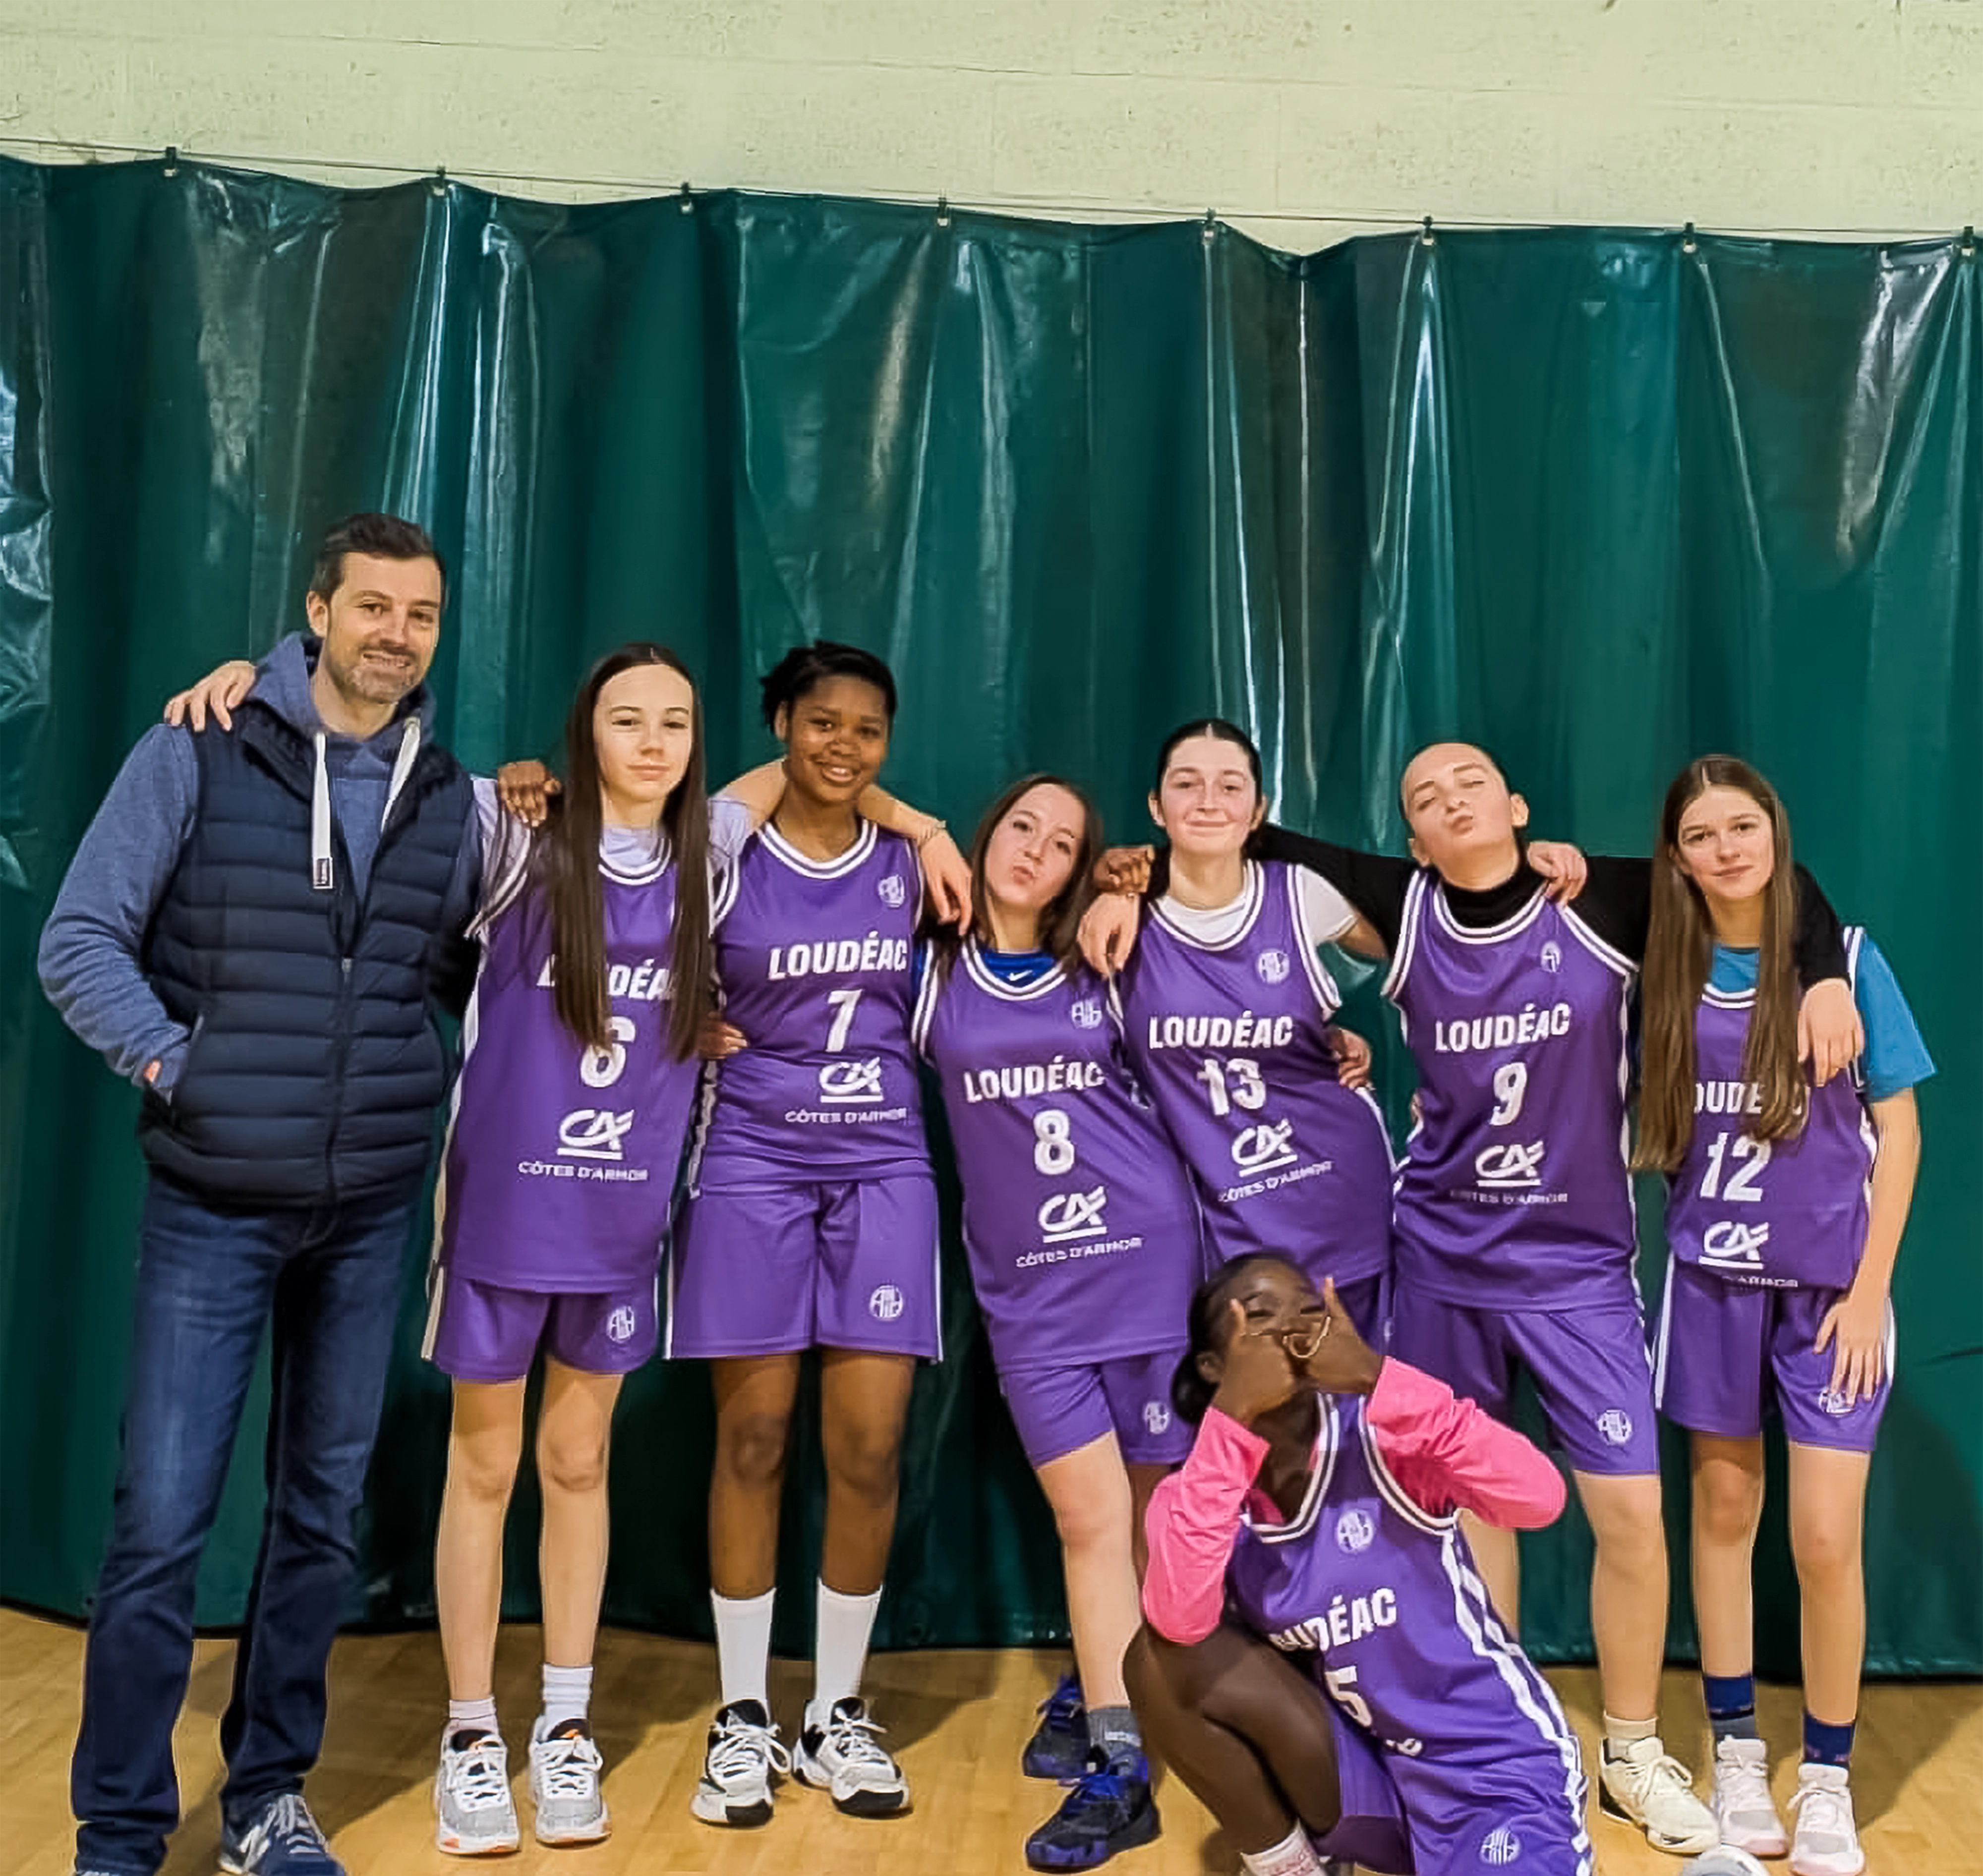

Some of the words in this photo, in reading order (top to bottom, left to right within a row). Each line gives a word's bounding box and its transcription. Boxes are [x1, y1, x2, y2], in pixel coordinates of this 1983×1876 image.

[536, 954, 673, 1001] LDÉA
[768, 931, 908, 981] LOUDÉAC
[825, 988, 863, 1053] 7
[1149, 1010, 1293, 1049] LOUDÉAC
[1435, 1002, 1572, 1053] LOUDÉAC
[580, 1016, 636, 1088] 6
[963, 1055, 1105, 1103] LOUDÉAC
[1197, 1058, 1266, 1116] 13
[1489, 1061, 1528, 1126] 9
[1033, 1109, 1075, 1175] 8
[1699, 1132, 1772, 1202] 12
[1325, 1665, 1373, 1728] 5
